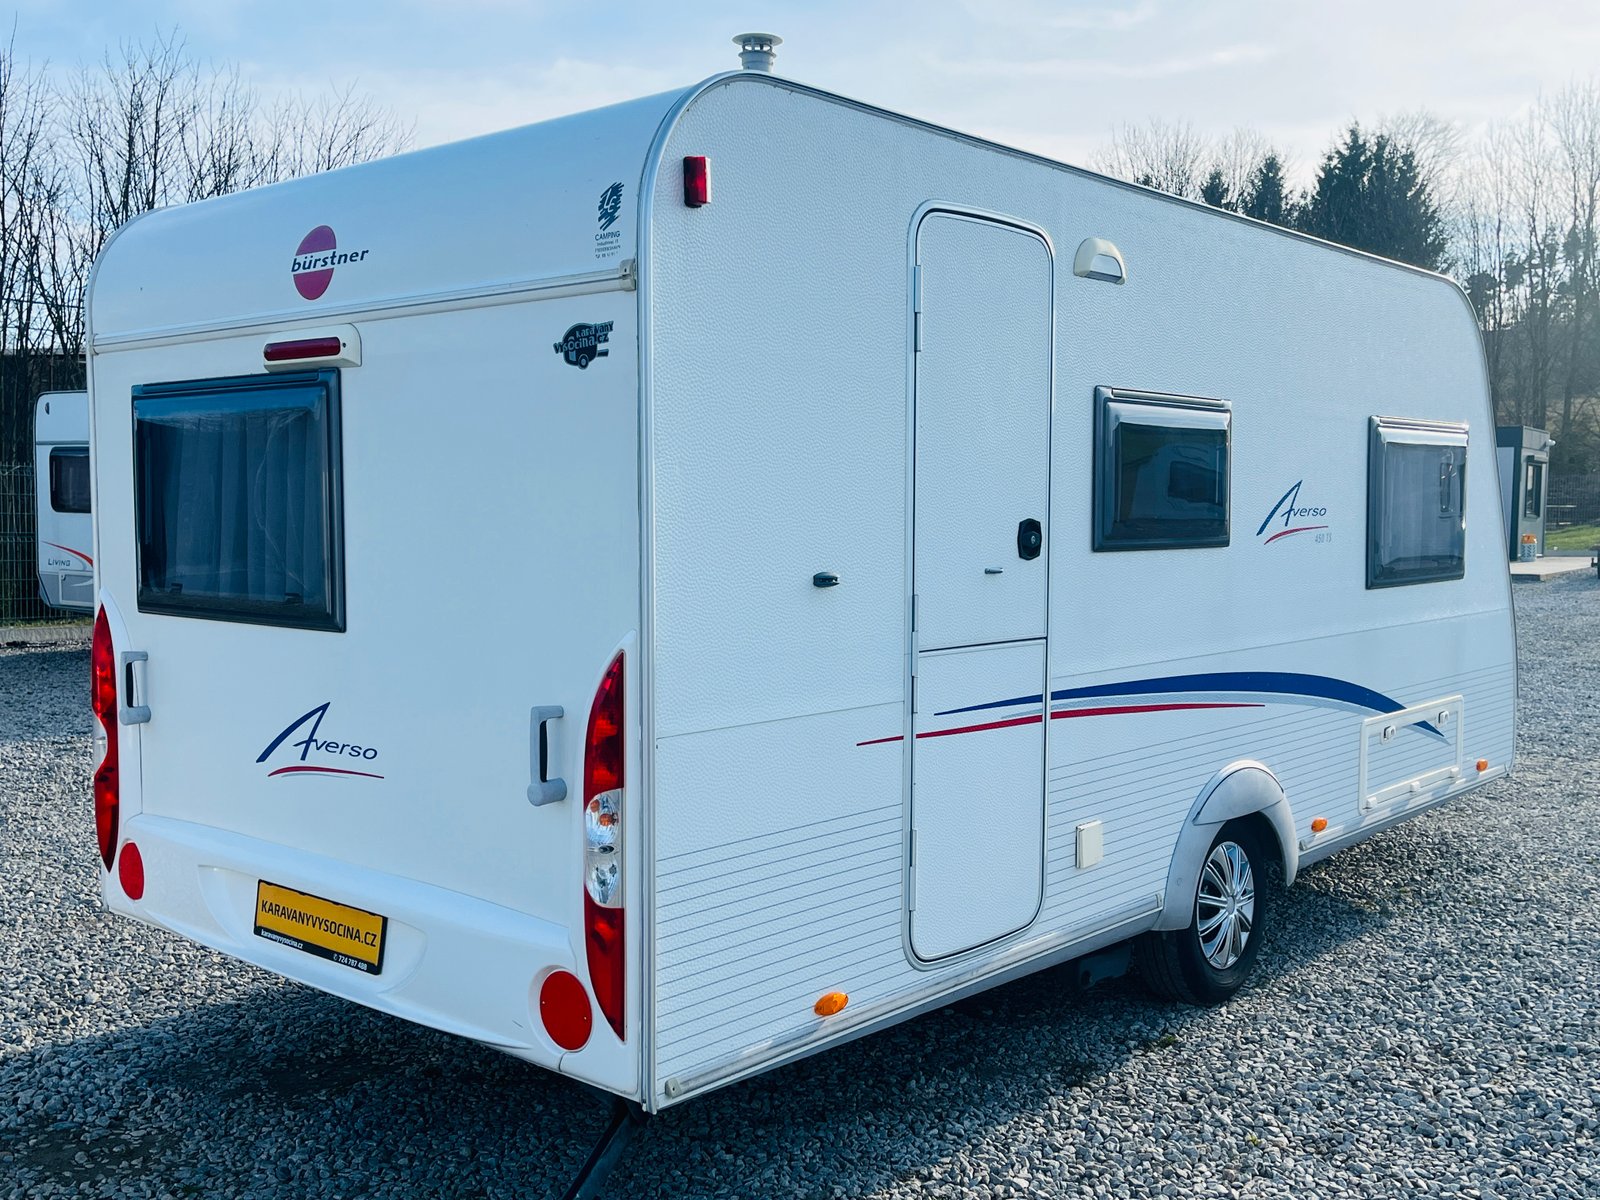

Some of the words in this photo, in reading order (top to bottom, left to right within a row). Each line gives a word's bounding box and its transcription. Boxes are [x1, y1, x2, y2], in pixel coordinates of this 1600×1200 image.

[594, 230, 621, 241] CAMPING
[291, 249, 369, 272] bürstner
[1256, 479, 1327, 536] Averso
[256, 701, 378, 763] Averso
[261, 899, 378, 947] KARAVANYVYSOCINA.CZ
